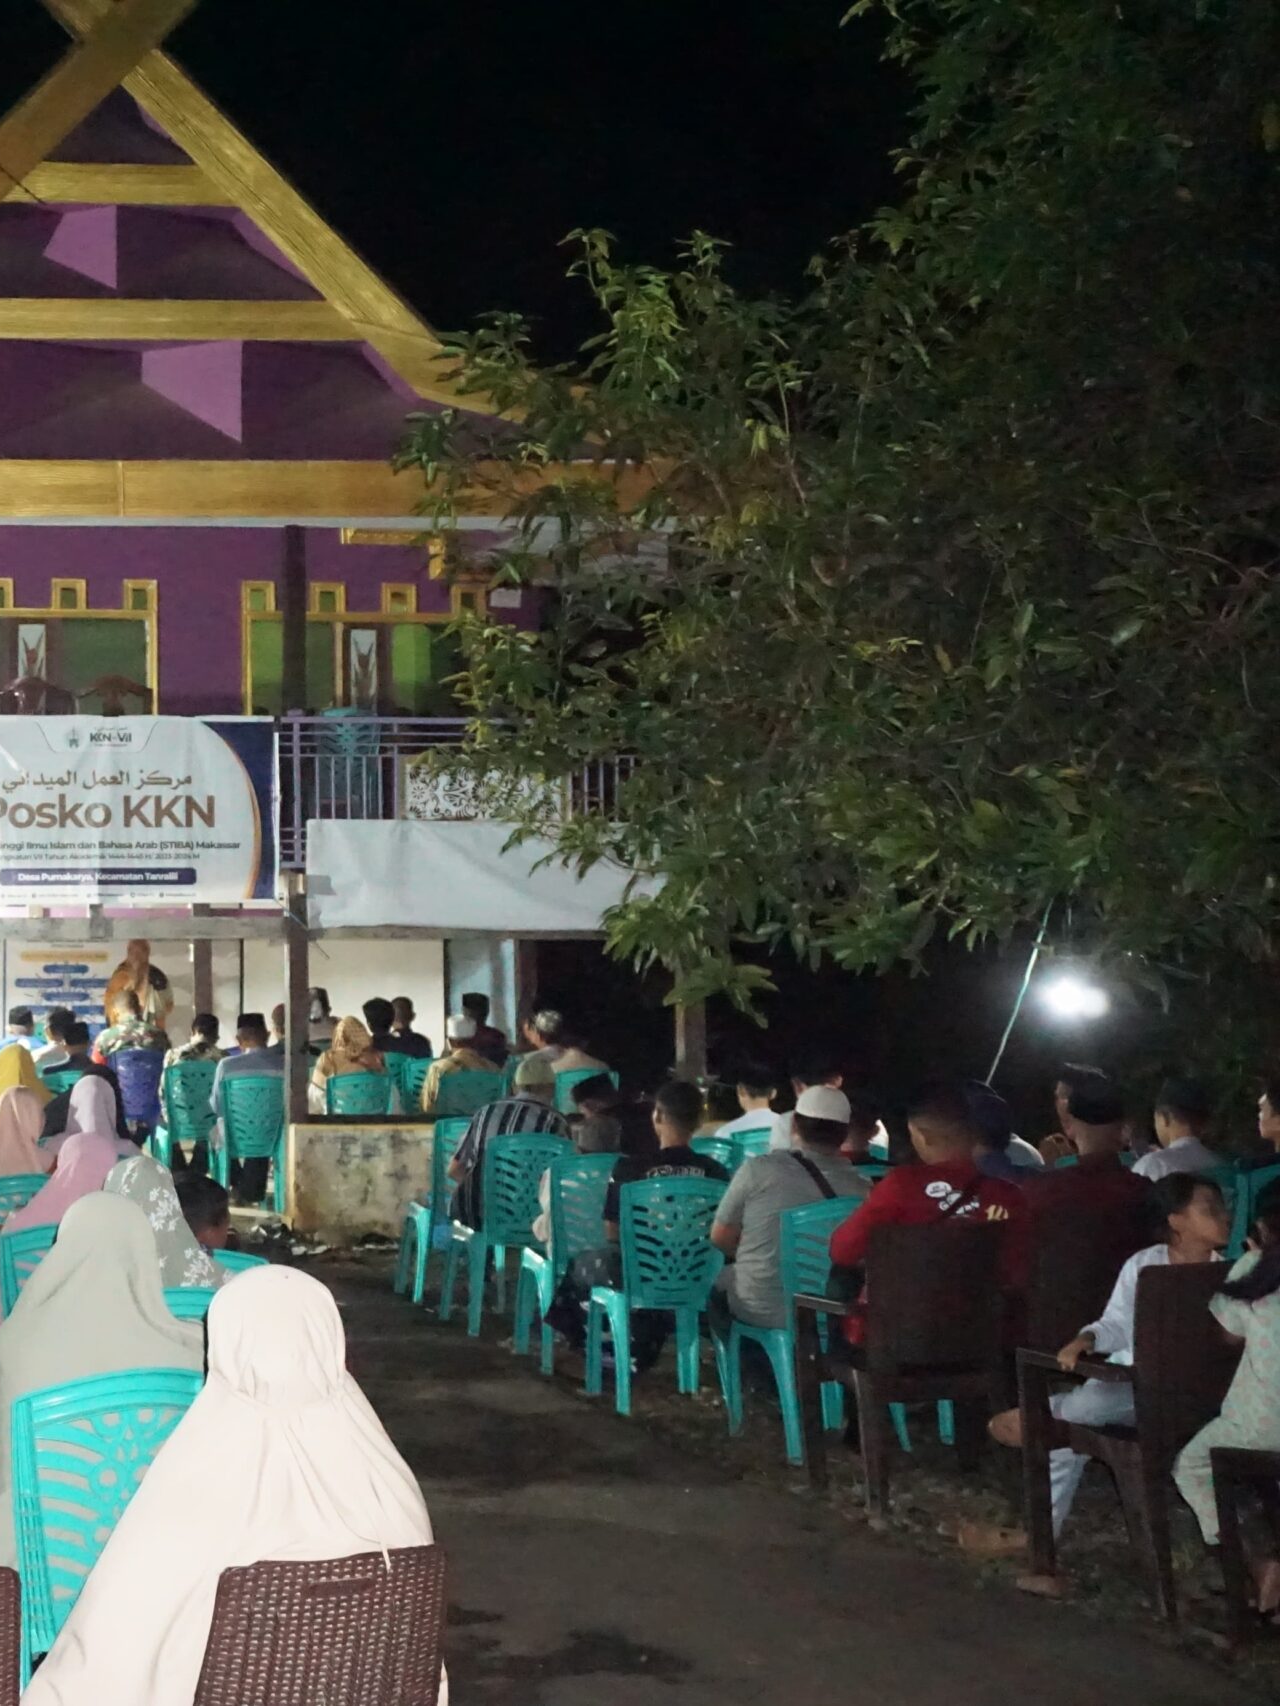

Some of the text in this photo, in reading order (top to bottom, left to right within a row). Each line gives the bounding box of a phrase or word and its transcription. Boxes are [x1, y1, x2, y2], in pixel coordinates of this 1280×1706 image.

[2, 770, 192, 793] مركز العمل الميداني
[123, 795, 216, 828] KKN
[135, 841, 158, 849] Arab
[196, 841, 240, 849] Makassar
